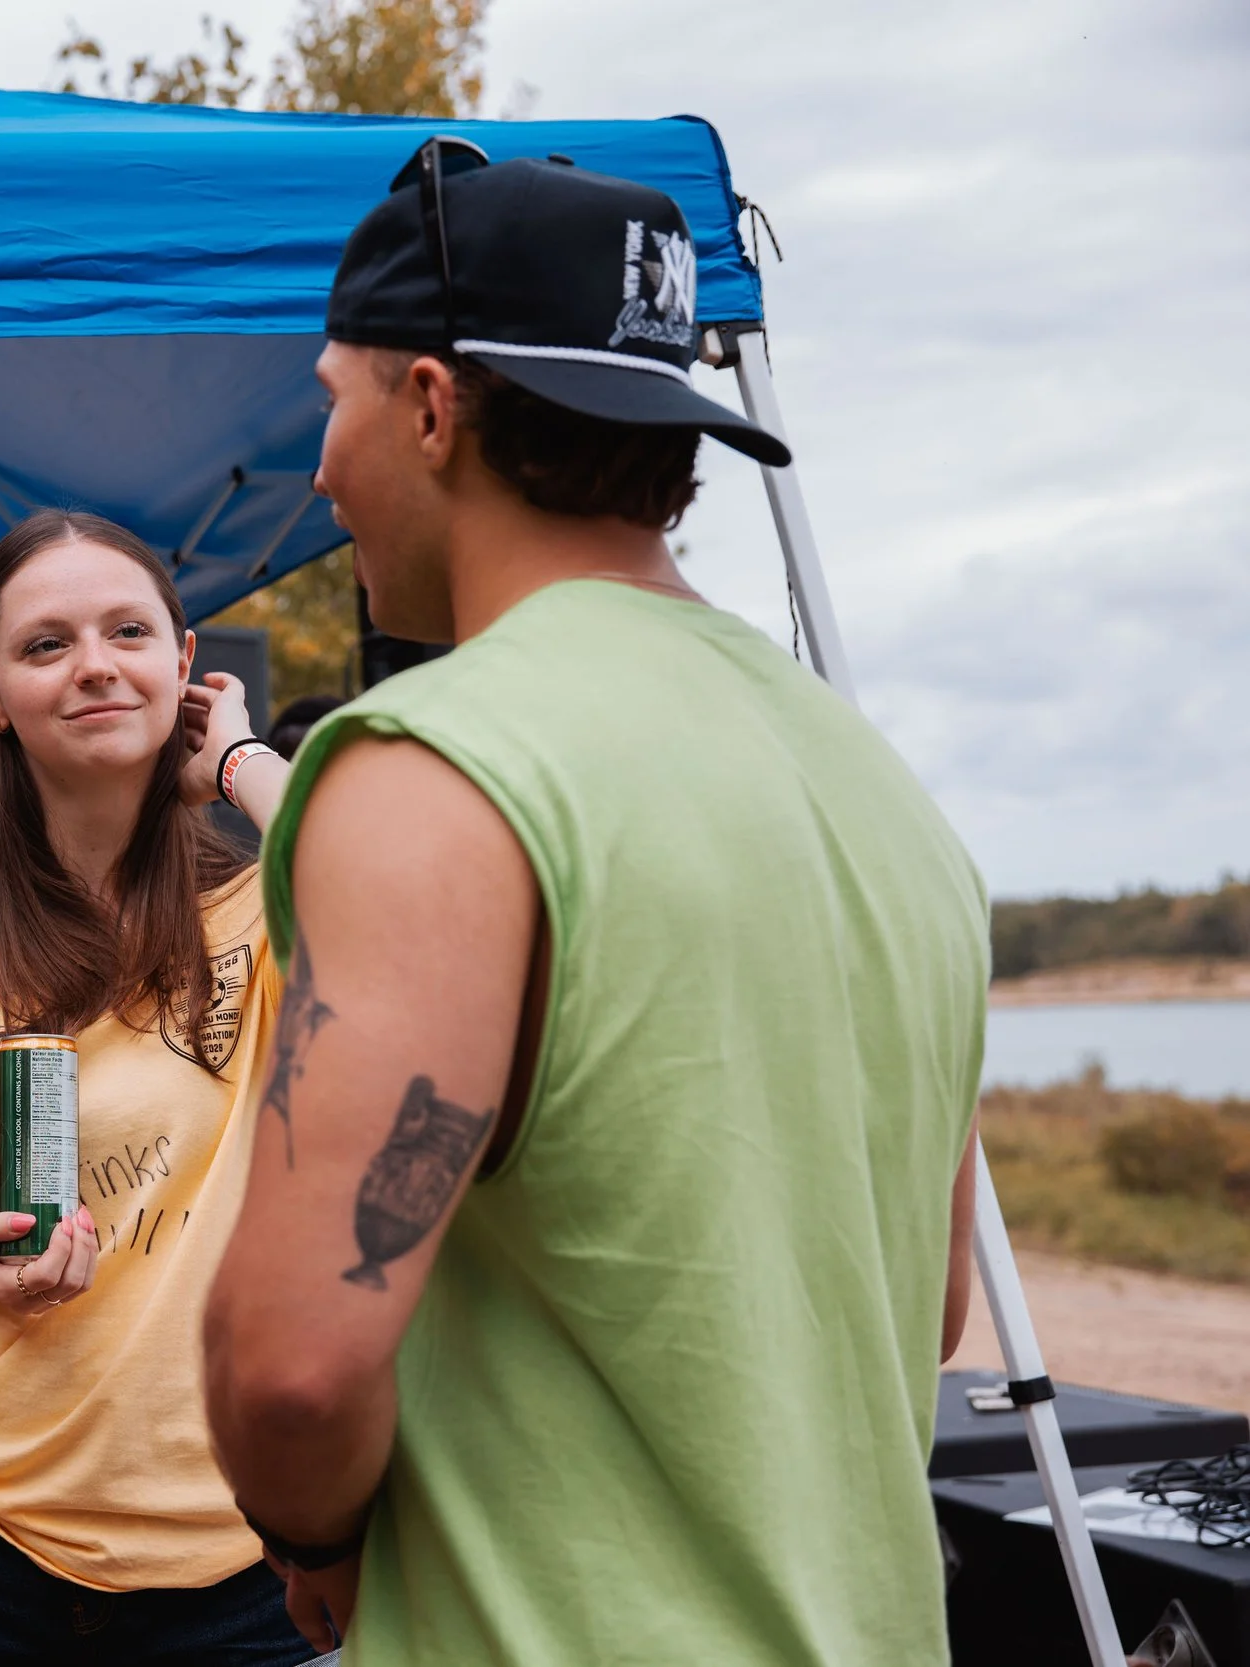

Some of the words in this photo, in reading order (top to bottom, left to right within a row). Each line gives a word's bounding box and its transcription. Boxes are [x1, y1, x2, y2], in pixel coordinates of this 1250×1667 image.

[625, 219, 645, 262] YORK
[223, 749, 248, 801] PARTY
[15, 1147, 22, 1157] DE
